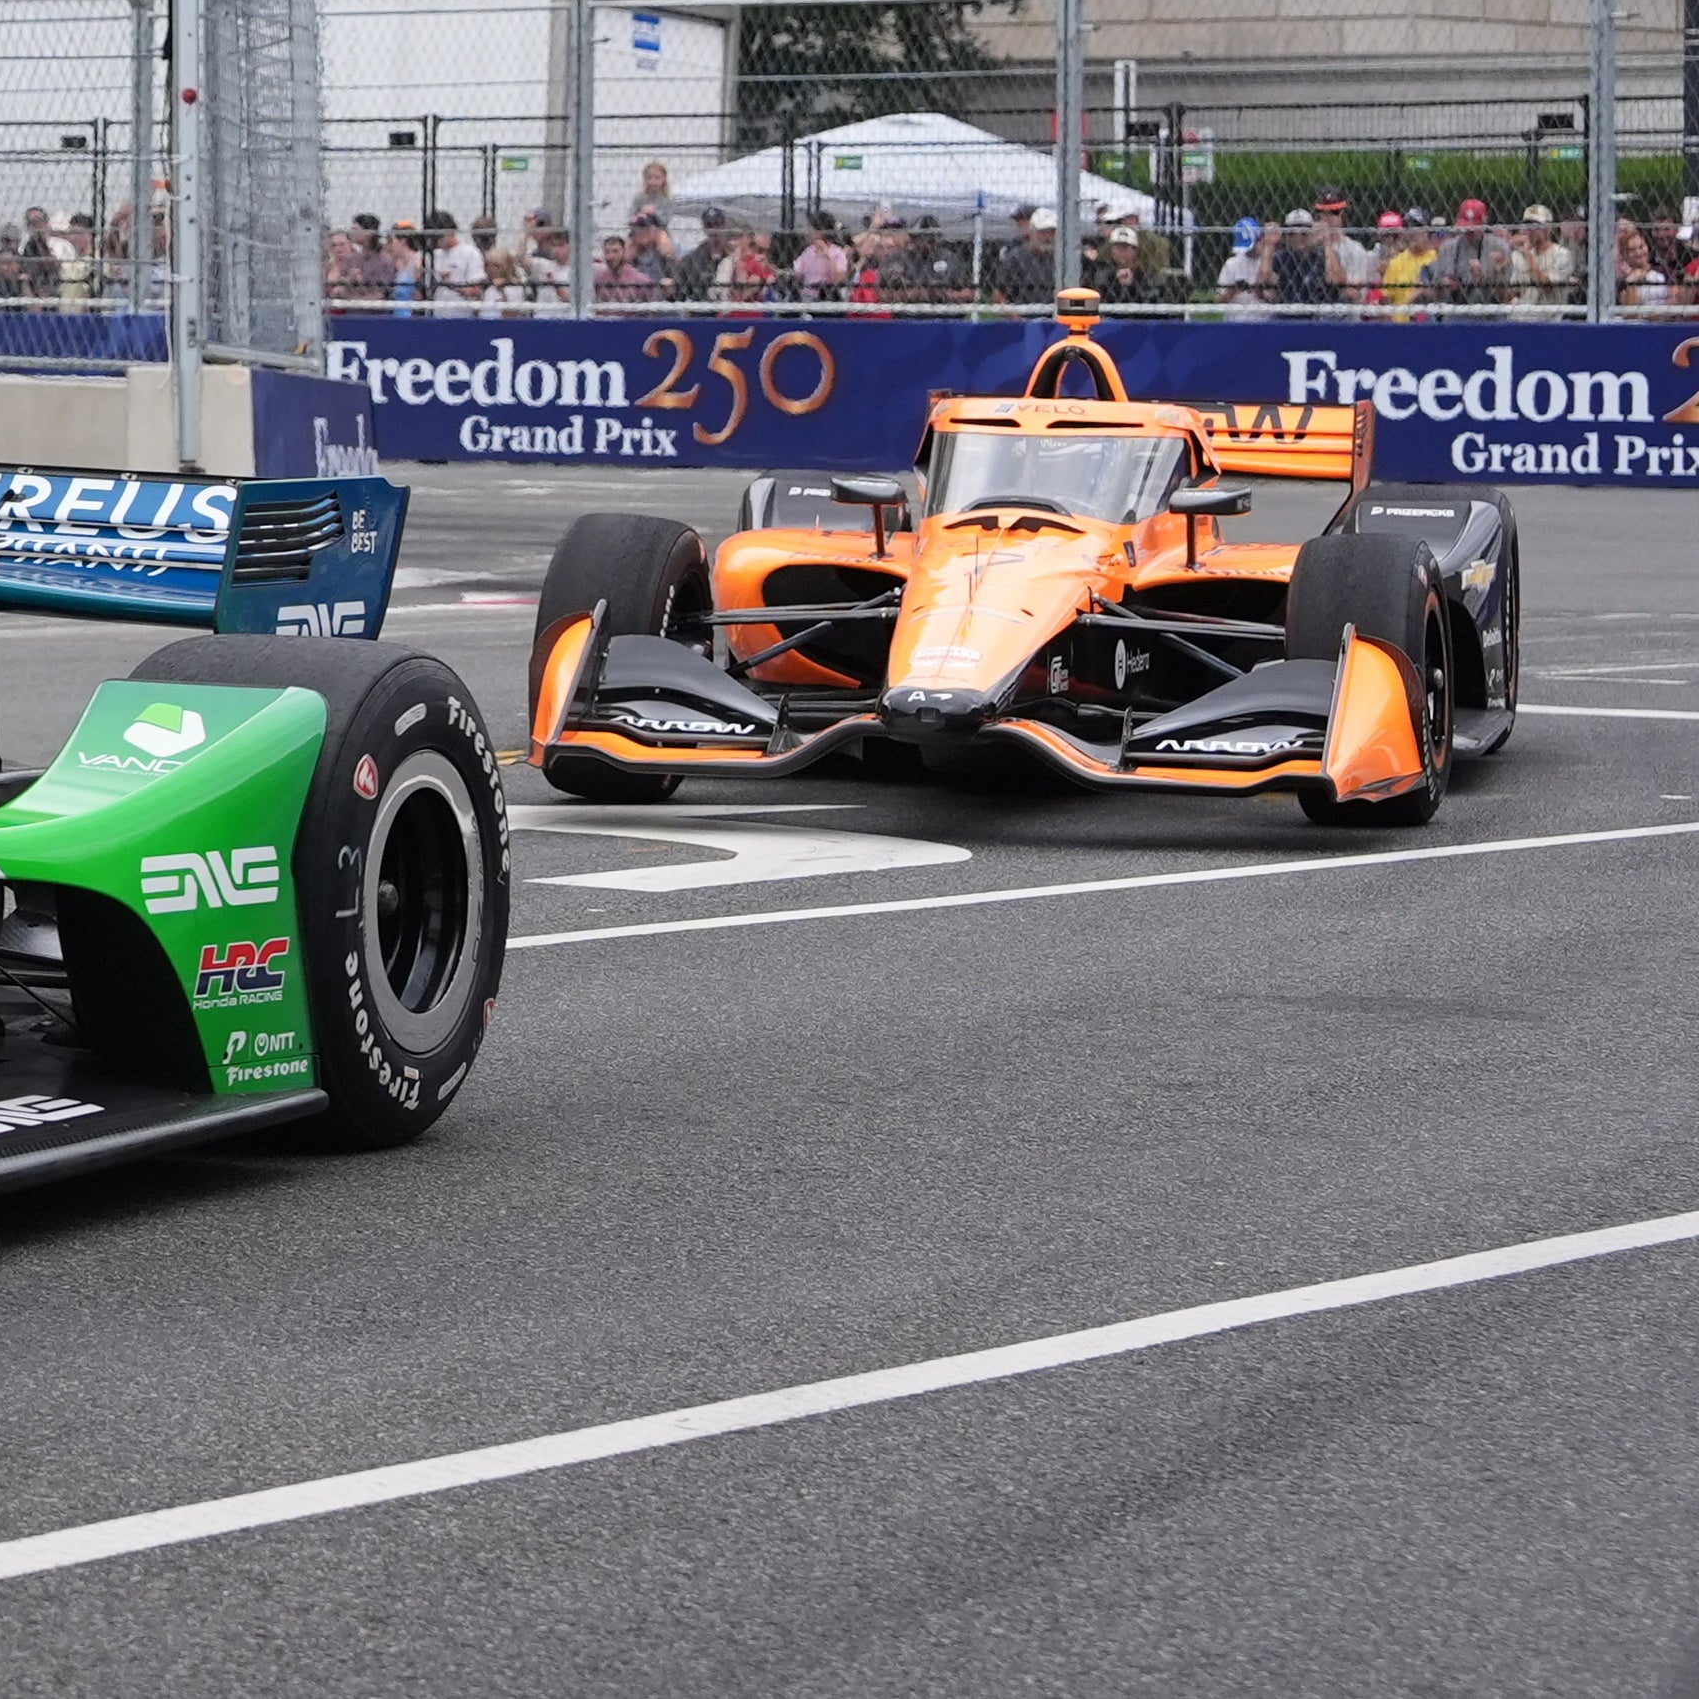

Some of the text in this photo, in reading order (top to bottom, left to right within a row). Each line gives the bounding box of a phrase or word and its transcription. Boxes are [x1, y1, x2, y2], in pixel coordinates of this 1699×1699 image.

[324, 326, 836, 447] Freedom 250
[1280, 346, 1656, 423] Freedom
[459, 414, 680, 458] Grand Prix
[1451, 431, 1602, 474] Grand
[352, 508, 366, 530] BE
[350, 531, 378, 555] BEST
[447, 695, 512, 874] Firestone
[192, 936, 291, 999] HRC
[192, 990, 284, 1011] Honda RACING
[343, 949, 421, 1111] Firestone
[225, 1059, 309, 1086] Firestone
